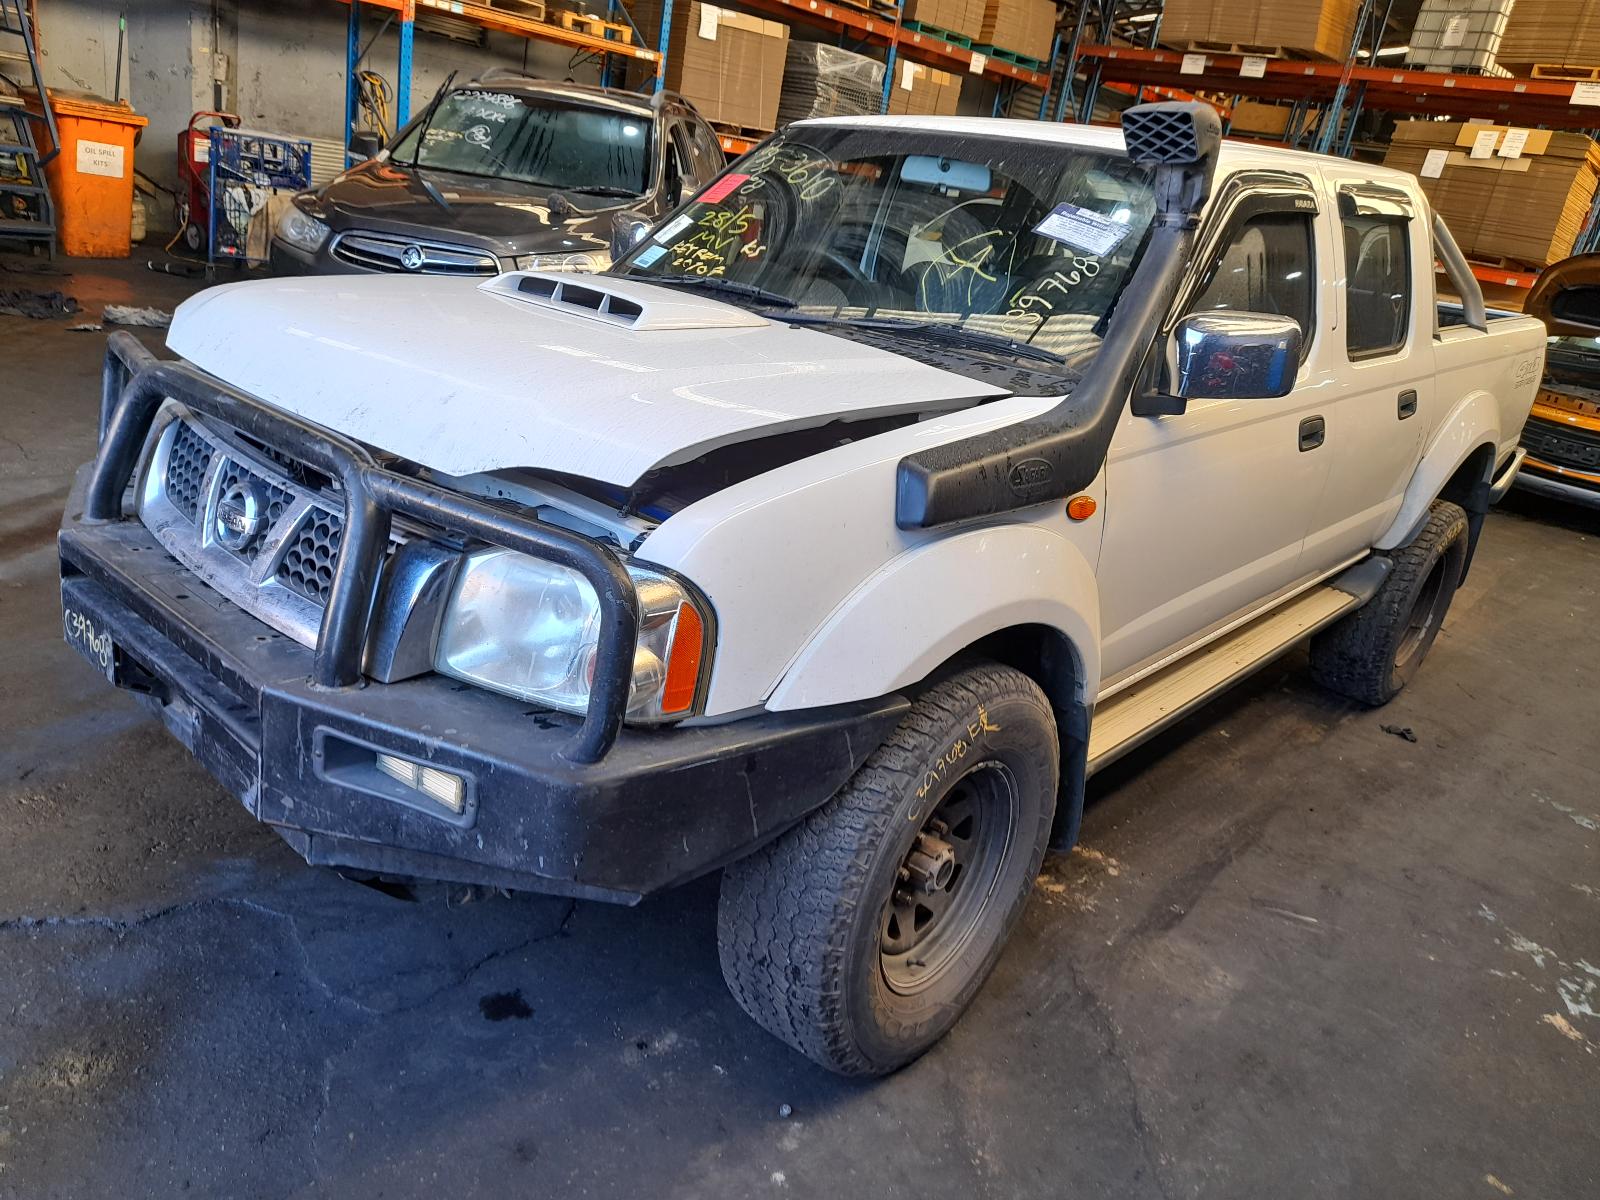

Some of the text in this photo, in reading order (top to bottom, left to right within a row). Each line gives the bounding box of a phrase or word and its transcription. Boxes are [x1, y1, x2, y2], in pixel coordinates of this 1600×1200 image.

[98, 149, 116, 157] SPILL
[697, 204, 756, 234] 28/5
[1060, 210, 1091, 226] Repairable
